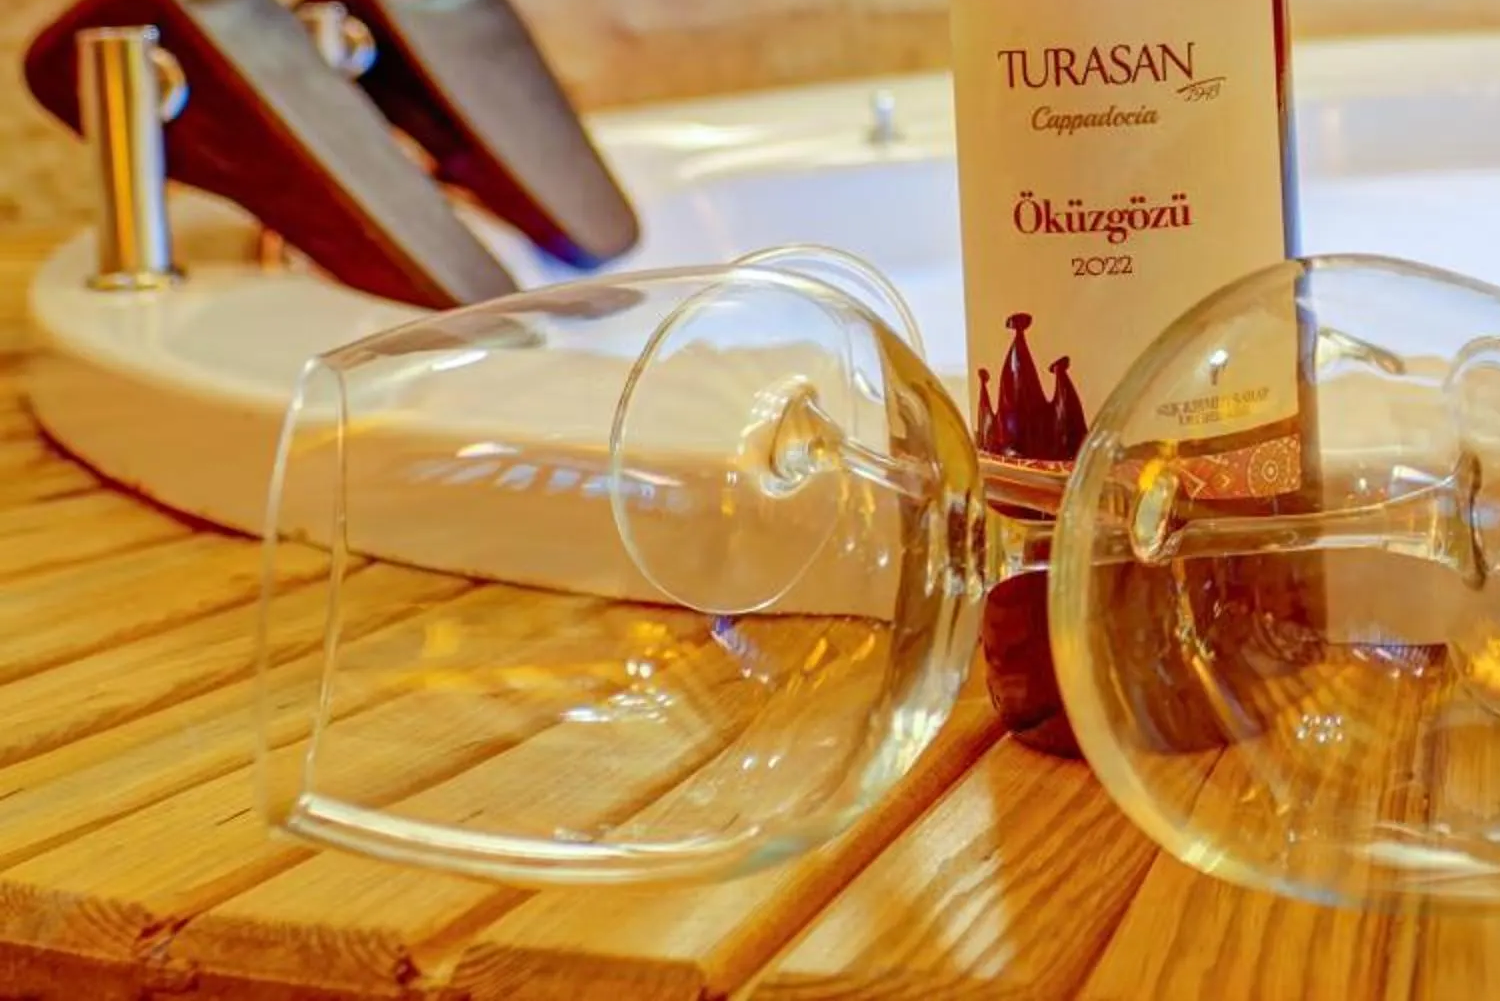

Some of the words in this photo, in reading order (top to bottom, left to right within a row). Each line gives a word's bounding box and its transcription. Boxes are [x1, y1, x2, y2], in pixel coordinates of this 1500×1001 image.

[997, 41, 1195, 90] TURASAN
[1031, 105, 1160, 136] Cappadocia
[1013, 190, 1194, 245] Öküzgözü
[1070, 255, 1134, 278] 2022
